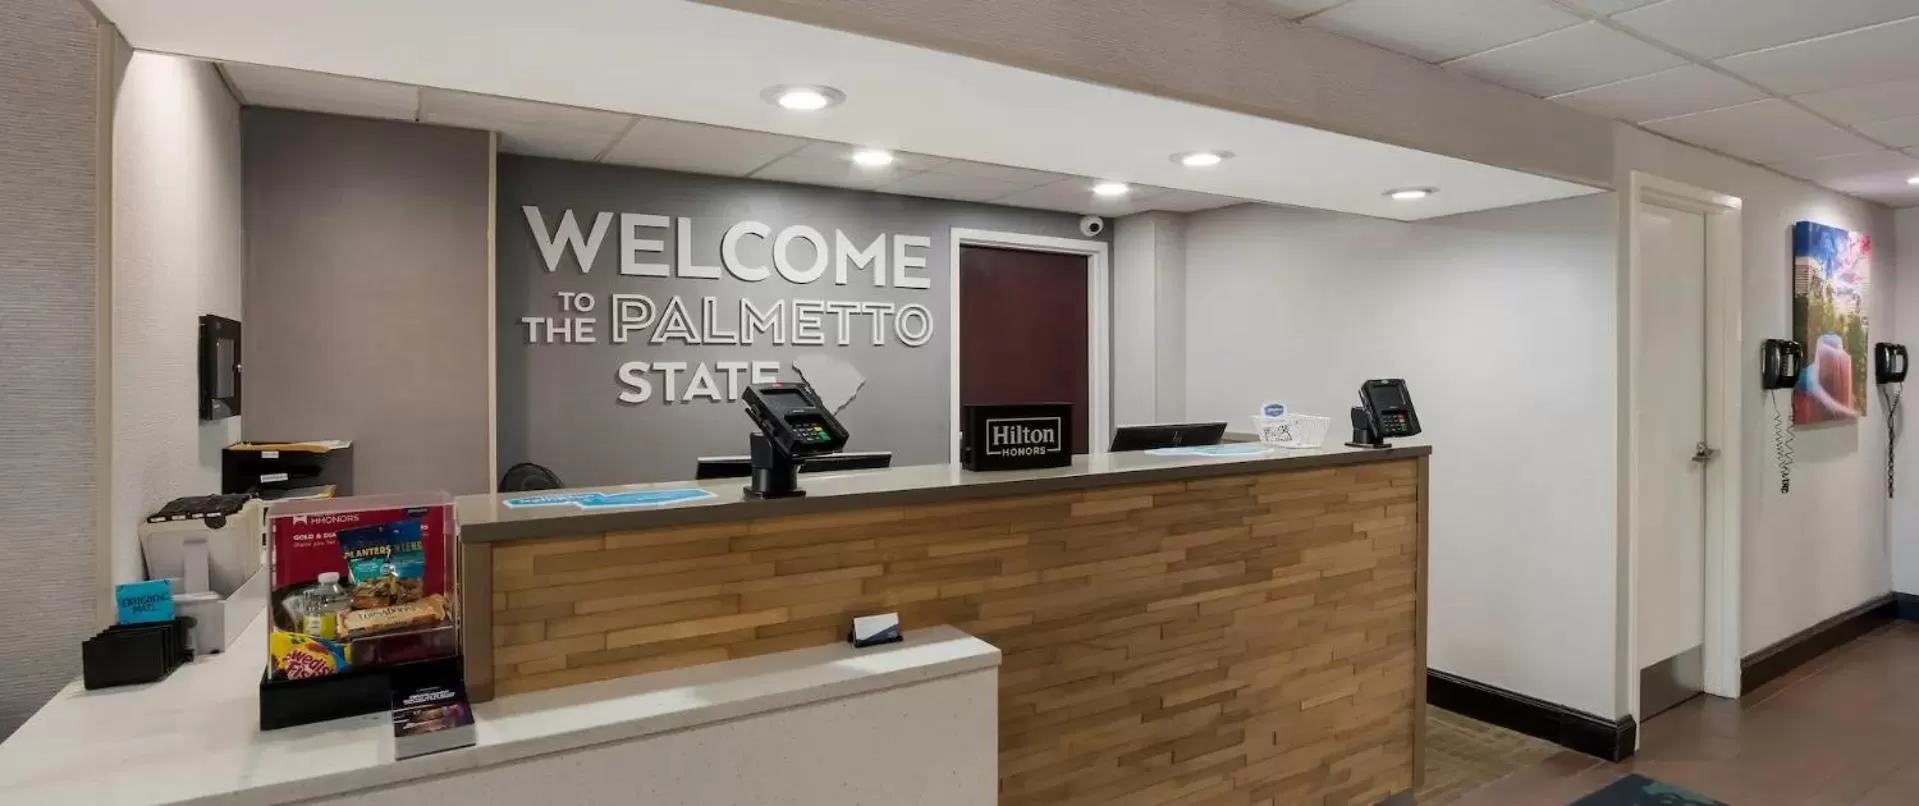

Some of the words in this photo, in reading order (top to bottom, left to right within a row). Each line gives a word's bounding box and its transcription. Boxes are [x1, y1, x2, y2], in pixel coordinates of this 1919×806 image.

[522, 204, 932, 290] WELCOME
[558, 291, 596, 313] TO
[521, 316, 597, 344] THE
[611, 292, 934, 347] PALMETTO
[992, 425, 1055, 446] Hilton
[1002, 446, 1046, 457] HONORS
[343, 544, 391, 559] PLANTERS
